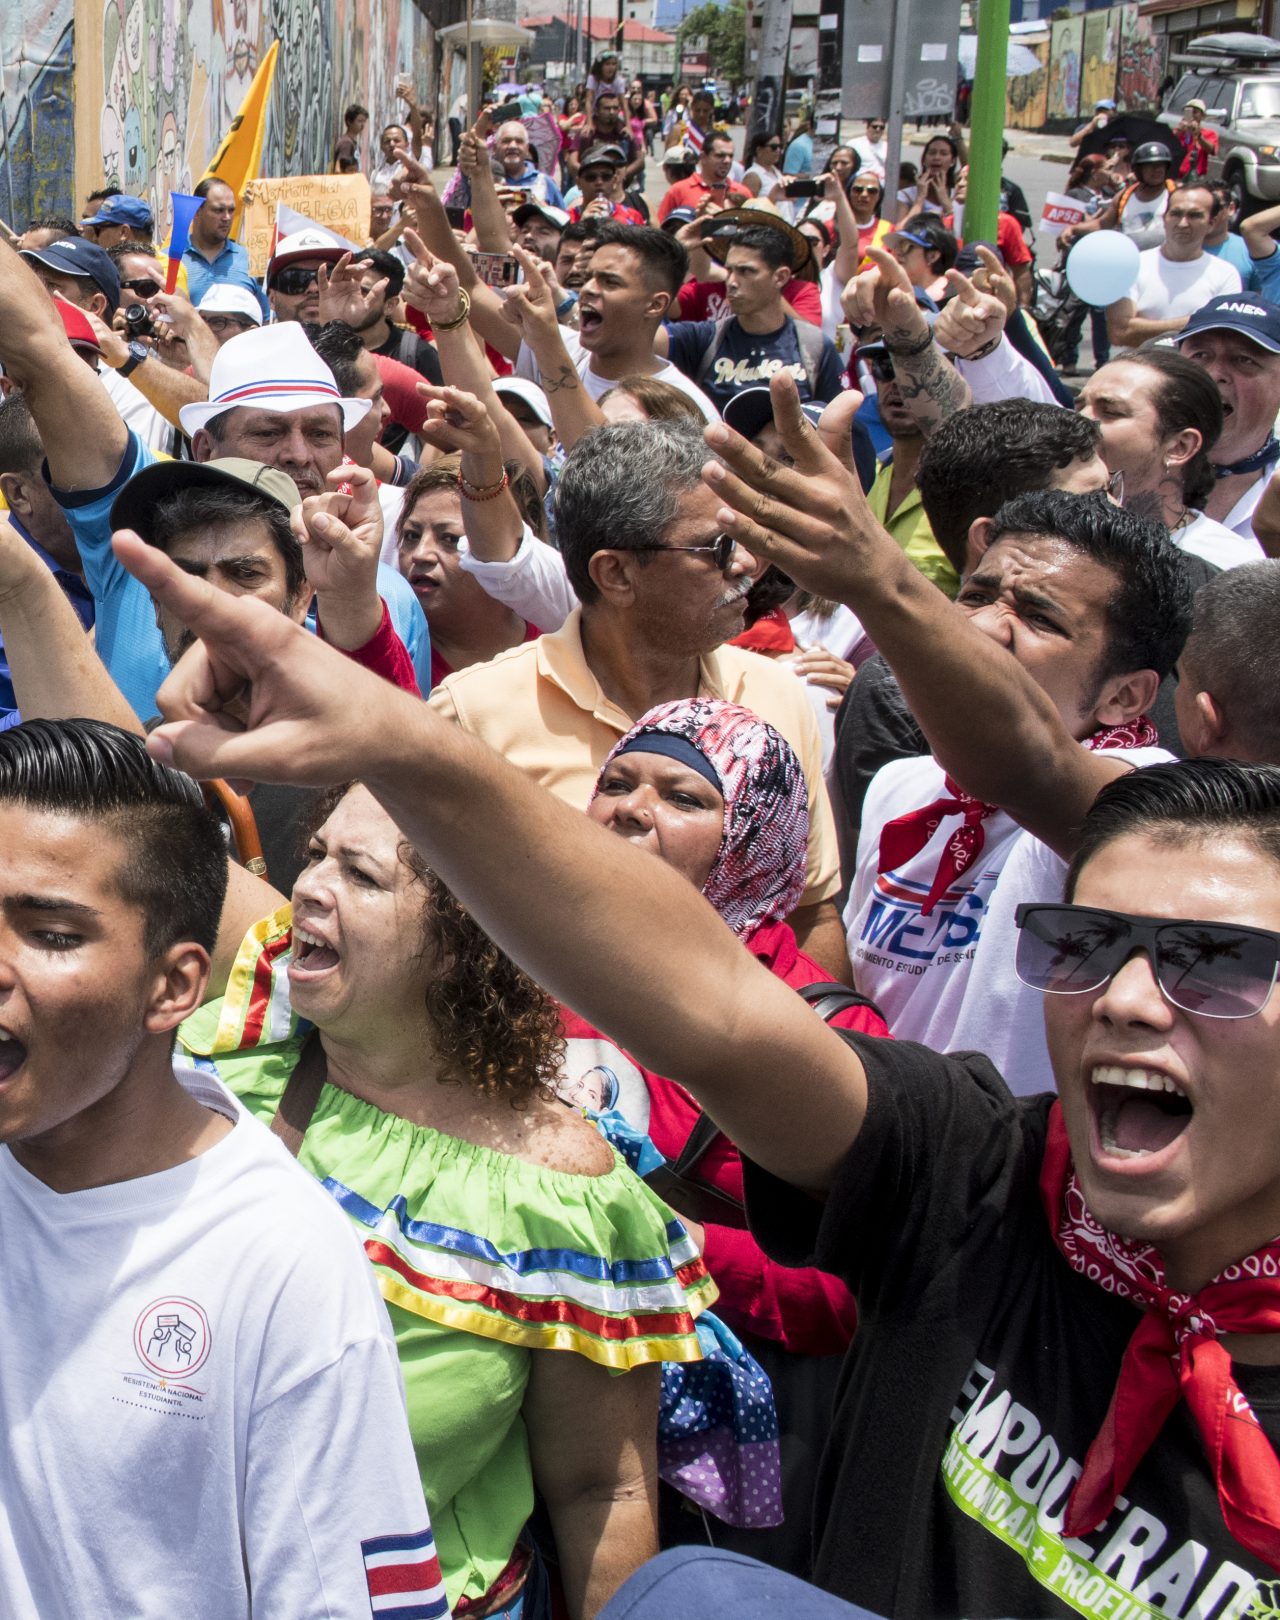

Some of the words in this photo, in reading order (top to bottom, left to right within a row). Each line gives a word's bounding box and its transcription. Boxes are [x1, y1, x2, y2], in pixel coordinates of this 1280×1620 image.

[123, 1376, 166, 1393] RESISTENCIA
[167, 1388, 204, 1402] NACIONAL
[138, 1390, 184, 1407] ESTUDIANTIL
